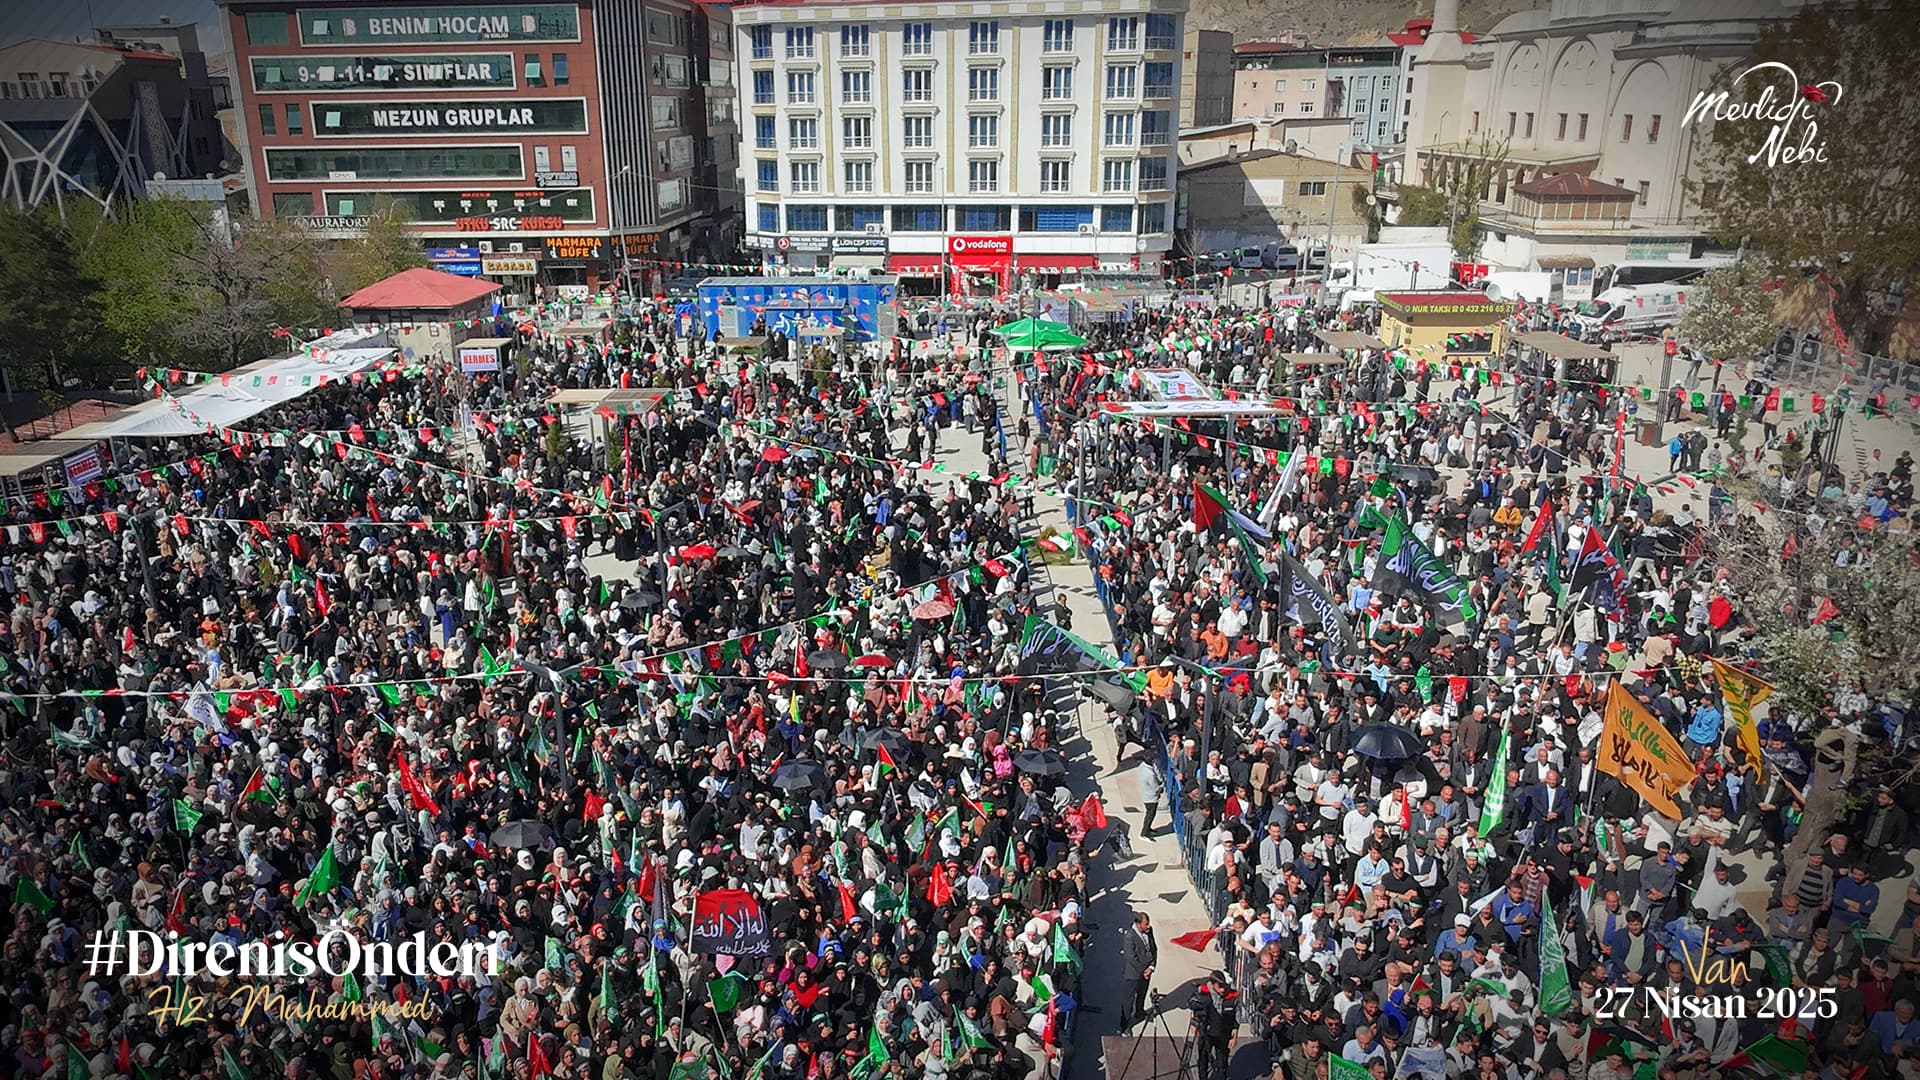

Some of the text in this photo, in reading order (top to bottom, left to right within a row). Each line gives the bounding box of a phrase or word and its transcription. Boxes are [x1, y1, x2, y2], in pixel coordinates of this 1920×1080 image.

[438, 16, 509, 33] HOCAM
[373, 108, 534, 126] MEZUN GRUPLAR
[455, 216, 563, 231] UTKU SRC KURSU
[546, 237, 602, 247] MARMARA
[966, 240, 1008, 248] vodafone
[560, 246, 590, 257] BÜFE
[1412, 305, 1428, 313] NUR
[463, 354, 496, 364] KERMES
[67, 456, 98, 478] KERMES
